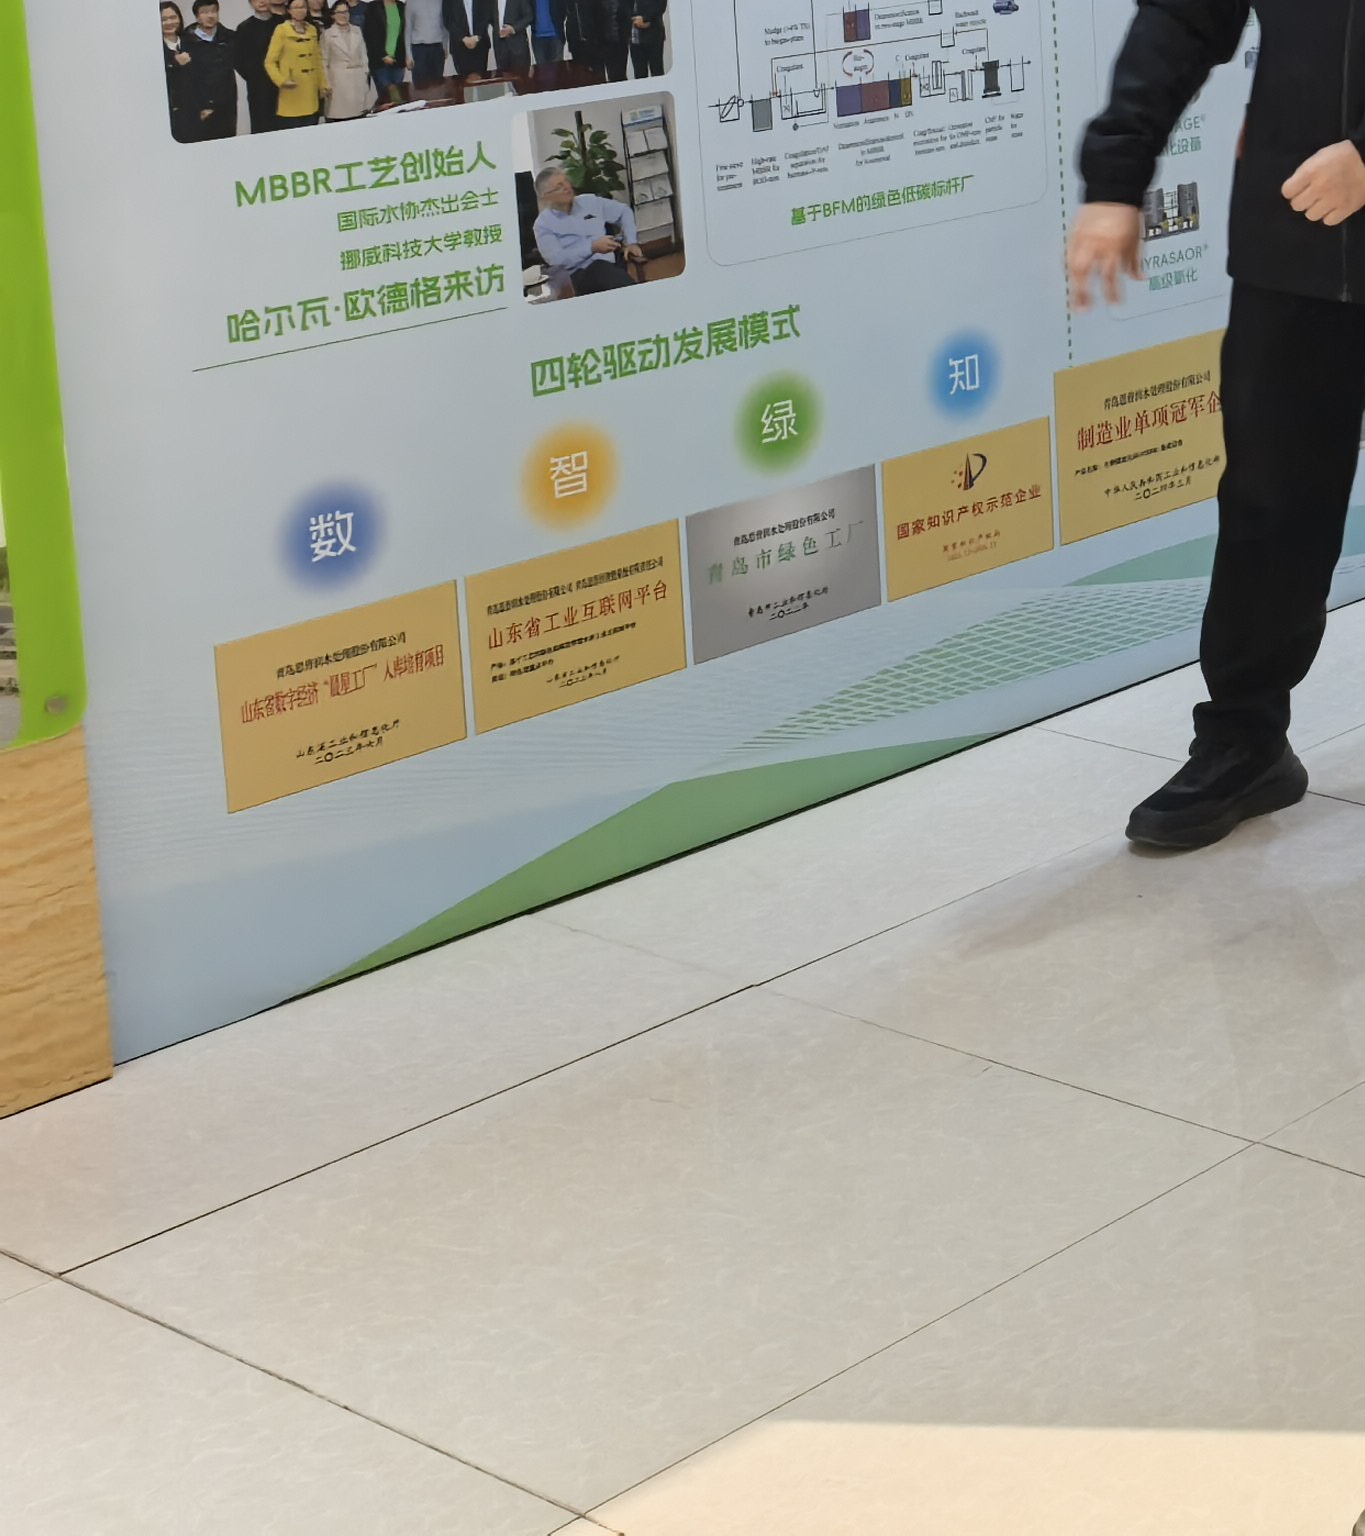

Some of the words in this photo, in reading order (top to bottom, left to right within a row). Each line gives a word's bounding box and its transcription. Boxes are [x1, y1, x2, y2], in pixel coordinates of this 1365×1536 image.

[234, 141, 497, 208] MBBR工艺创始人
[791, 175, 975, 226] 基于BFM的绿色低碳标杆厂
[337, 188, 500, 233] 国际水协杰出会士
[340, 223, 503, 271] 挪威科技大学教授
[226, 264, 505, 344] 哈尔瓦·欧德格来访
[530, 305, 801, 398] 四轮驱动发展模式
[948, 354, 981, 395] 知
[761, 399, 799, 444] 绿
[549, 450, 589, 499] 智
[307, 509, 358, 563] 数
[896, 483, 1042, 541] 国家知识产权示范企业
[488, 579, 668, 651] 山东省工业互联网平台
